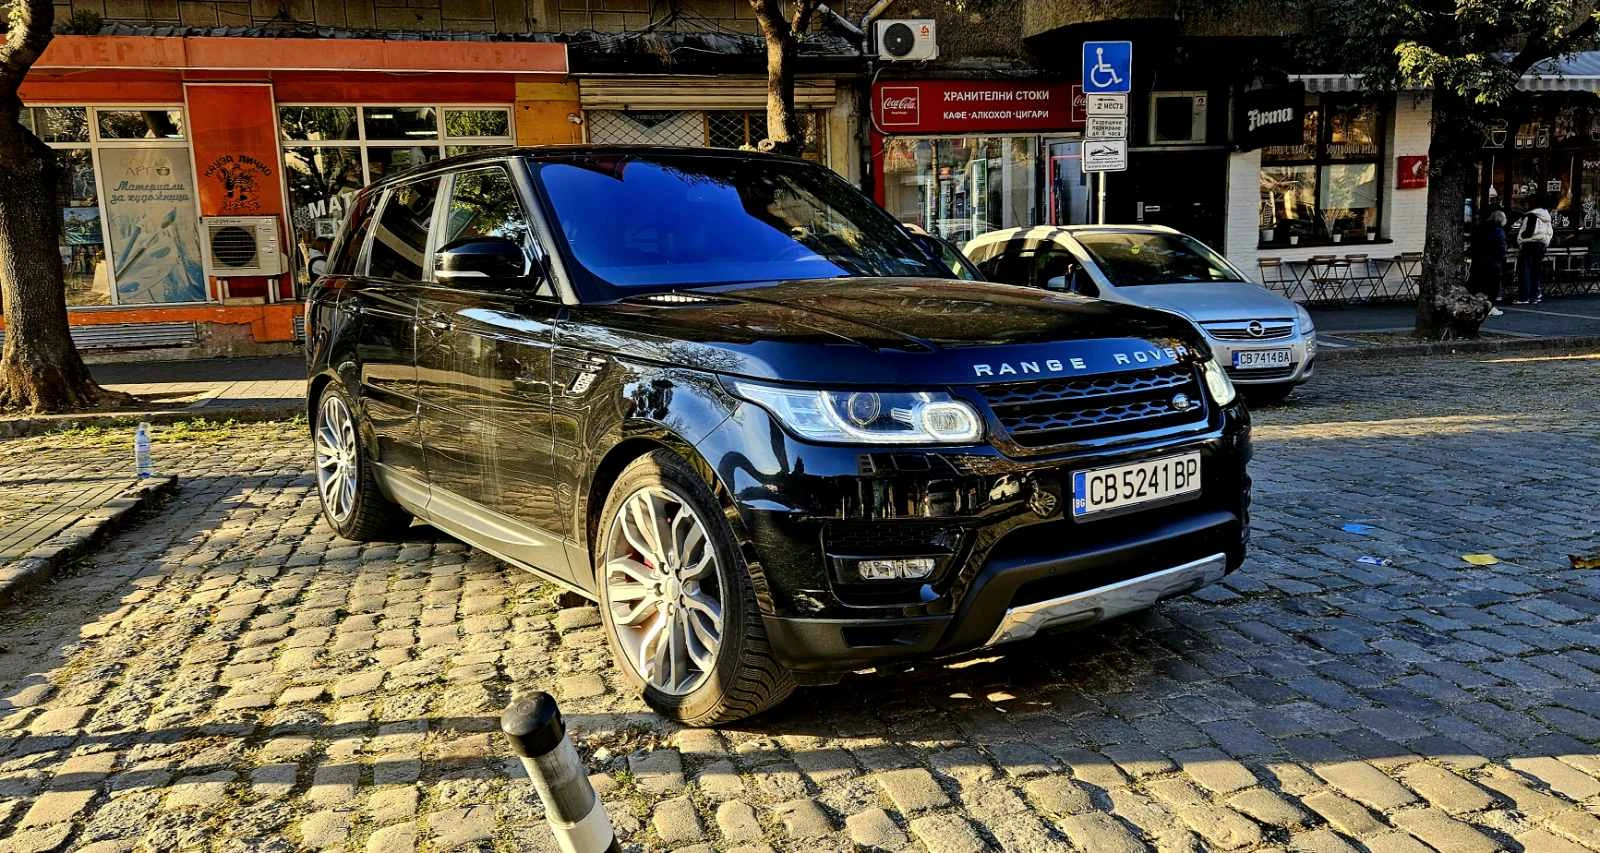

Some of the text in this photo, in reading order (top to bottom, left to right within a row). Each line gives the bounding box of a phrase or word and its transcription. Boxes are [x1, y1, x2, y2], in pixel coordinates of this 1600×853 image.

[943, 90, 1050, 101] ХРАНИТЕЛНИ СТОКИ
[943, 110, 1049, 120] КАФЕ АЛКОХОЛ ЦИГАРИ
[112, 180, 185, 192] Материали
[973, 345, 1188, 377] RANGE ROVER
[1240, 351, 1290, 365] CB 7414 BA
[1090, 458, 1198, 506] CB 5241 BP
[1075, 498, 1087, 509] BG
